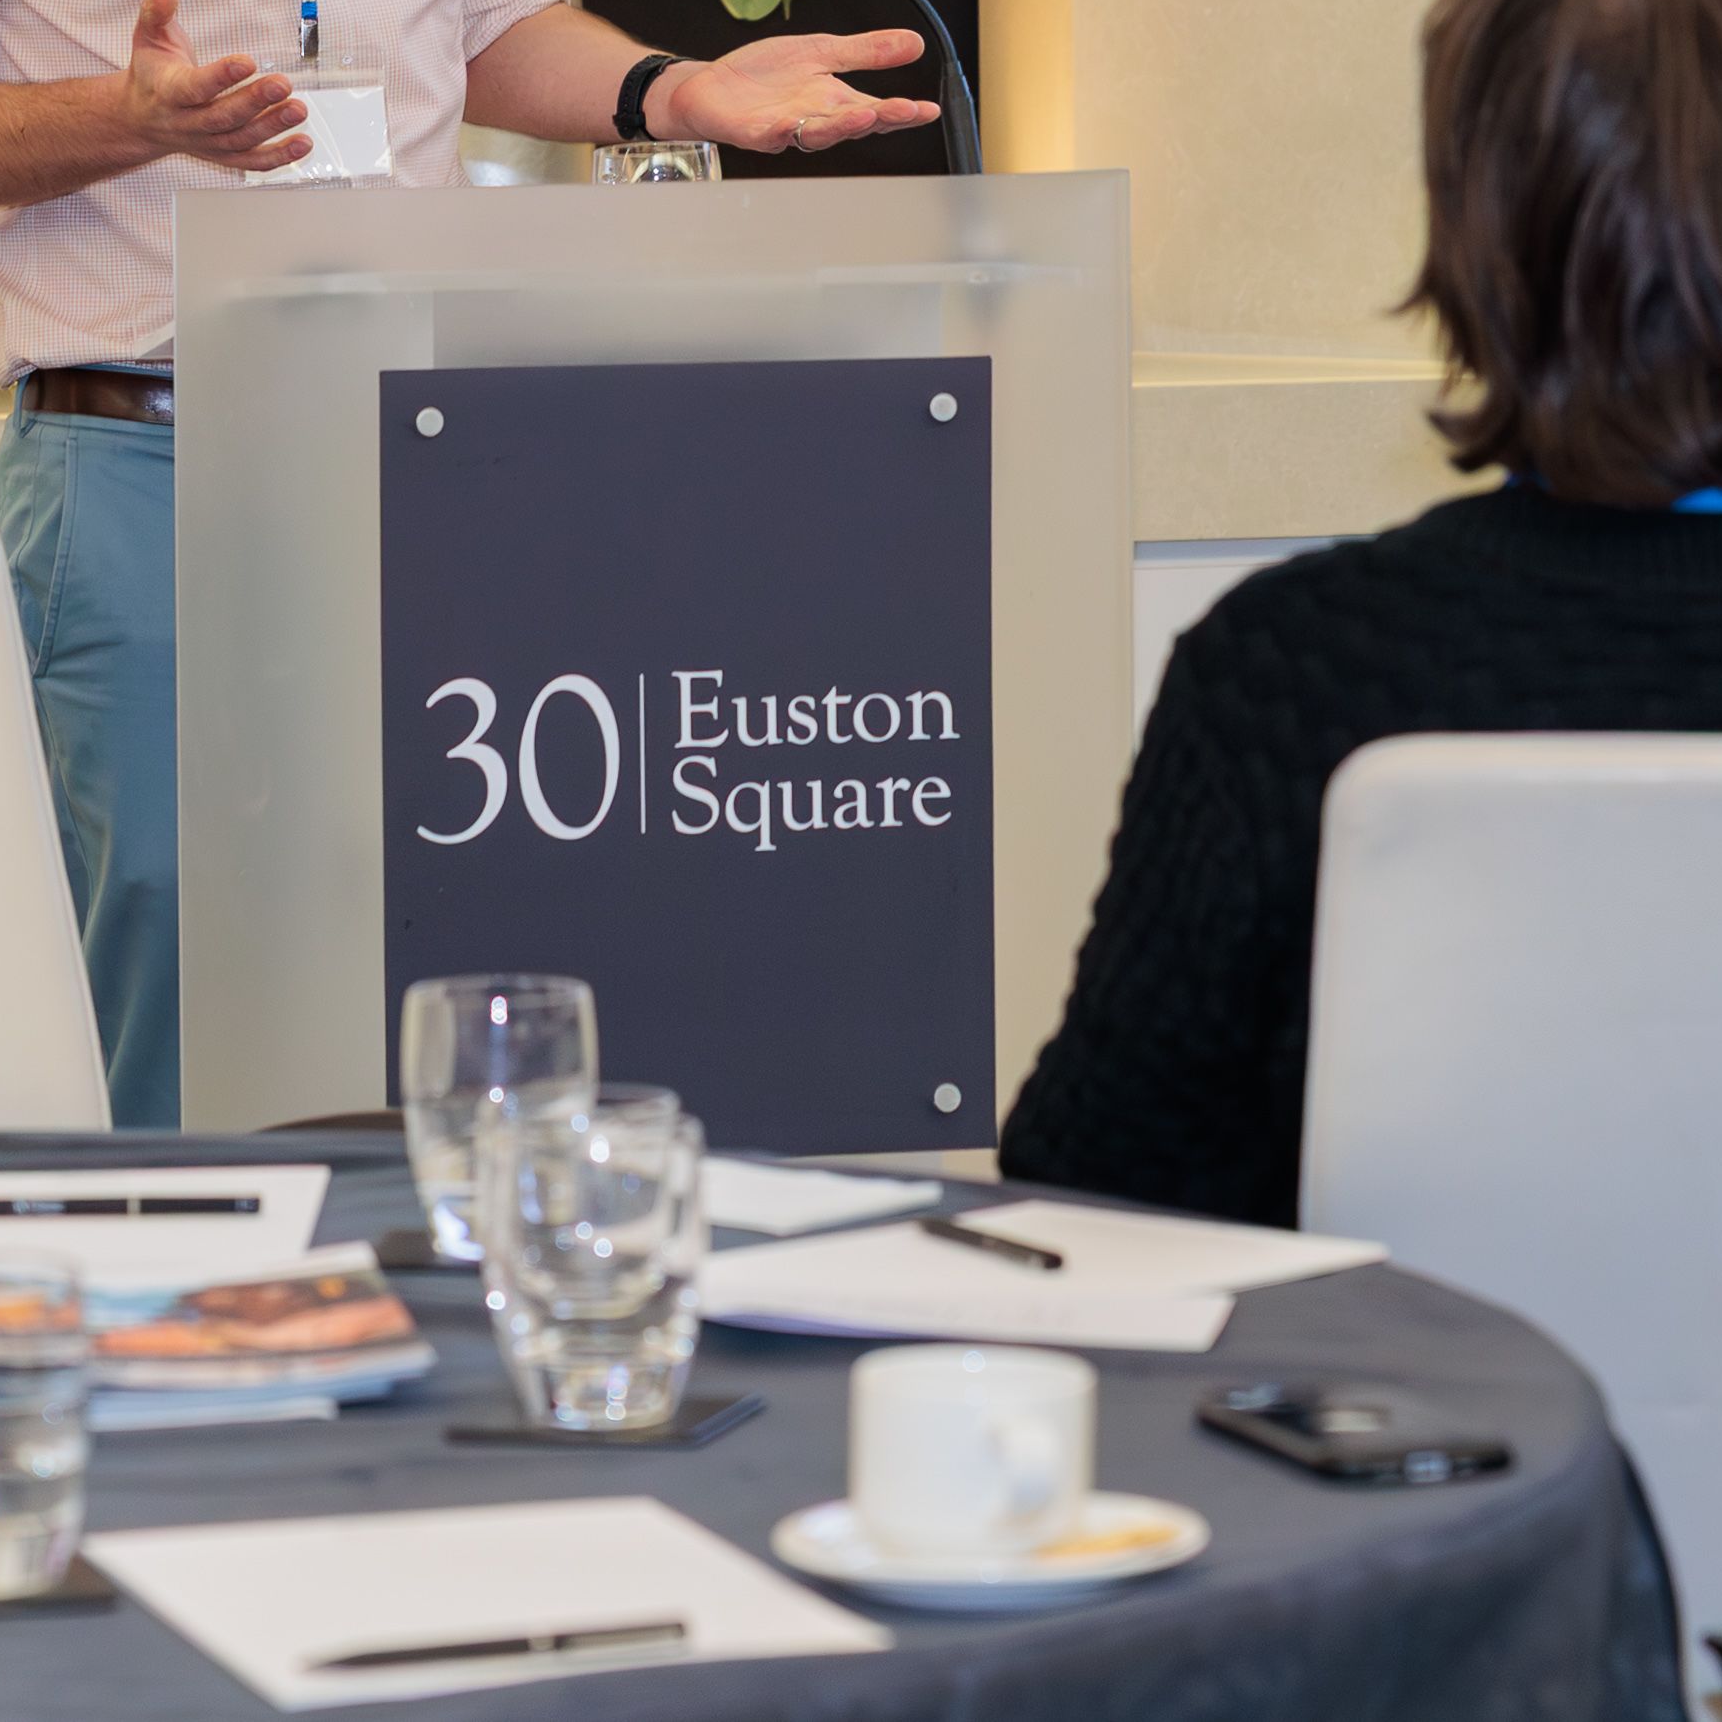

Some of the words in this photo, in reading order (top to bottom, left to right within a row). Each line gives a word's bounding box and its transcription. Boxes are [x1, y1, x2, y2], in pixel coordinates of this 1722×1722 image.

[416, 673, 620, 845] 30
[671, 669, 961, 749] Euston
[671, 755, 953, 852] Square
